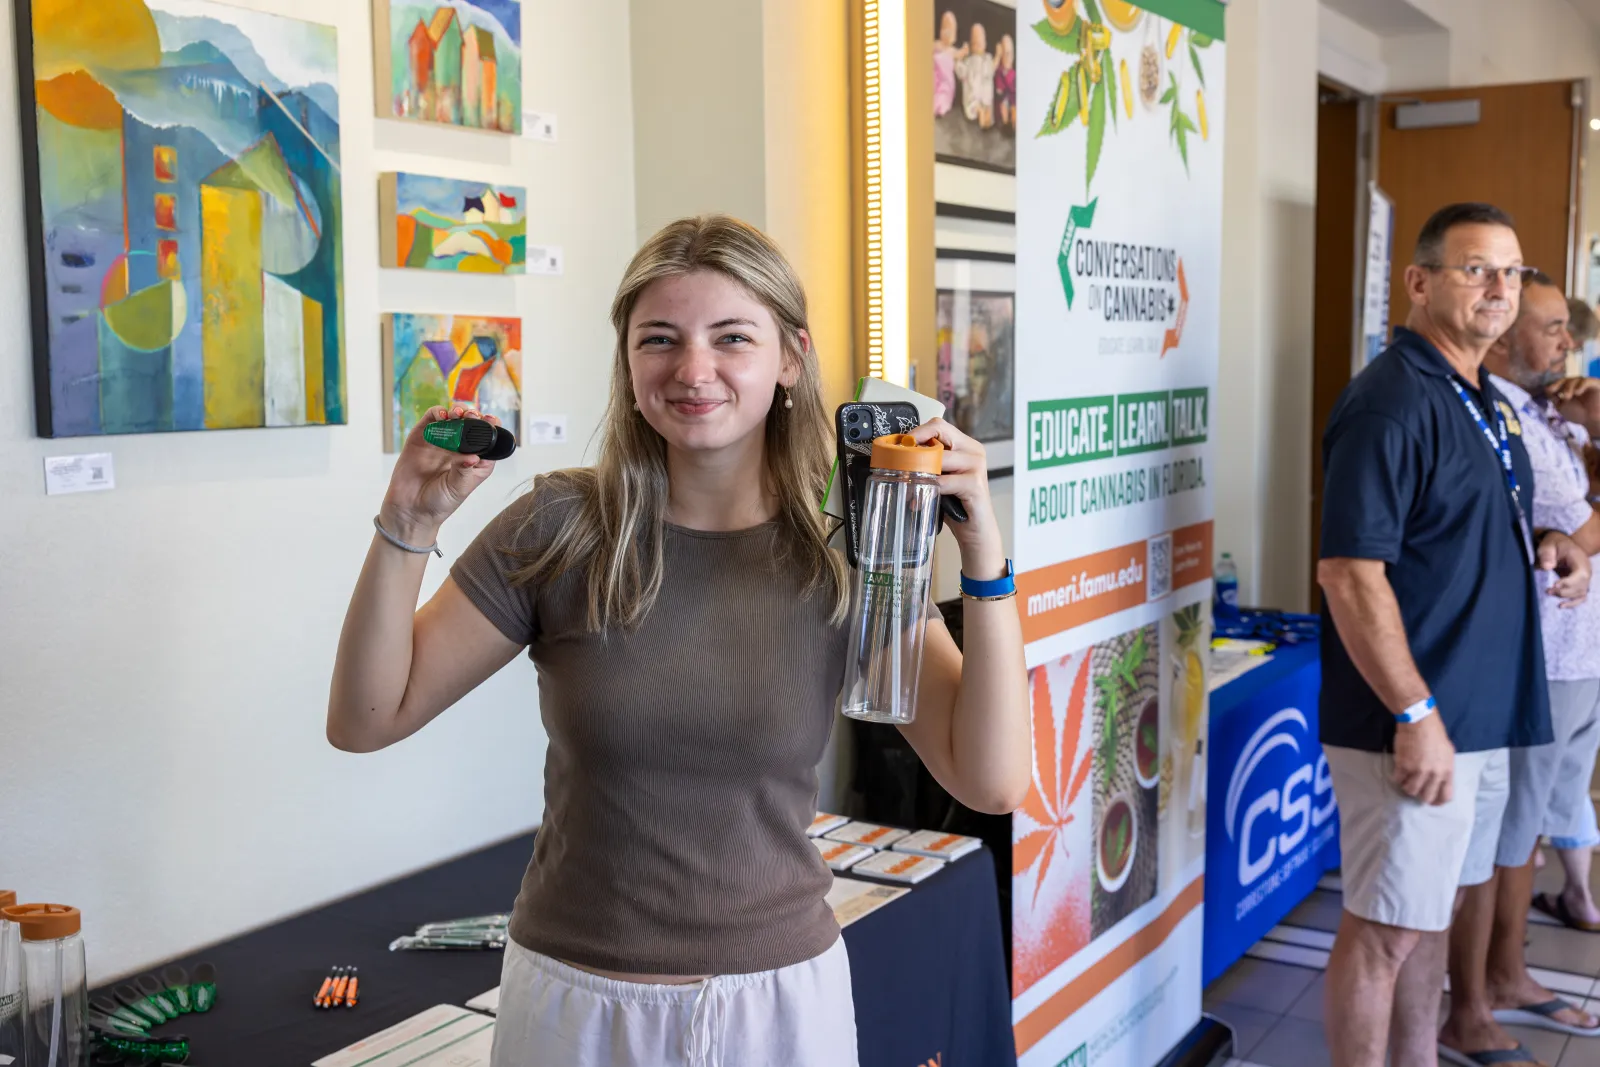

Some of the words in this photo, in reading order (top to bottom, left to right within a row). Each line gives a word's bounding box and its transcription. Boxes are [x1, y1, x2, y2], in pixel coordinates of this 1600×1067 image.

[1075, 239, 1176, 282] CONVERSATIONS
[1104, 285, 1167, 322] CANNABIS
[1030, 405, 1113, 462] EDUCATE.
[1118, 399, 1169, 449] LEARN.
[1173, 395, 1207, 440] TALK.
[1028, 481, 1077, 527] ABOUT
[1080, 468, 1146, 516] CANNABIS
[1149, 466, 1160, 500] IN
[865, 572, 890, 585] FAMU
[1027, 559, 1143, 617] mmeri.famu.edu
[1239, 754, 1337, 887] CSS
